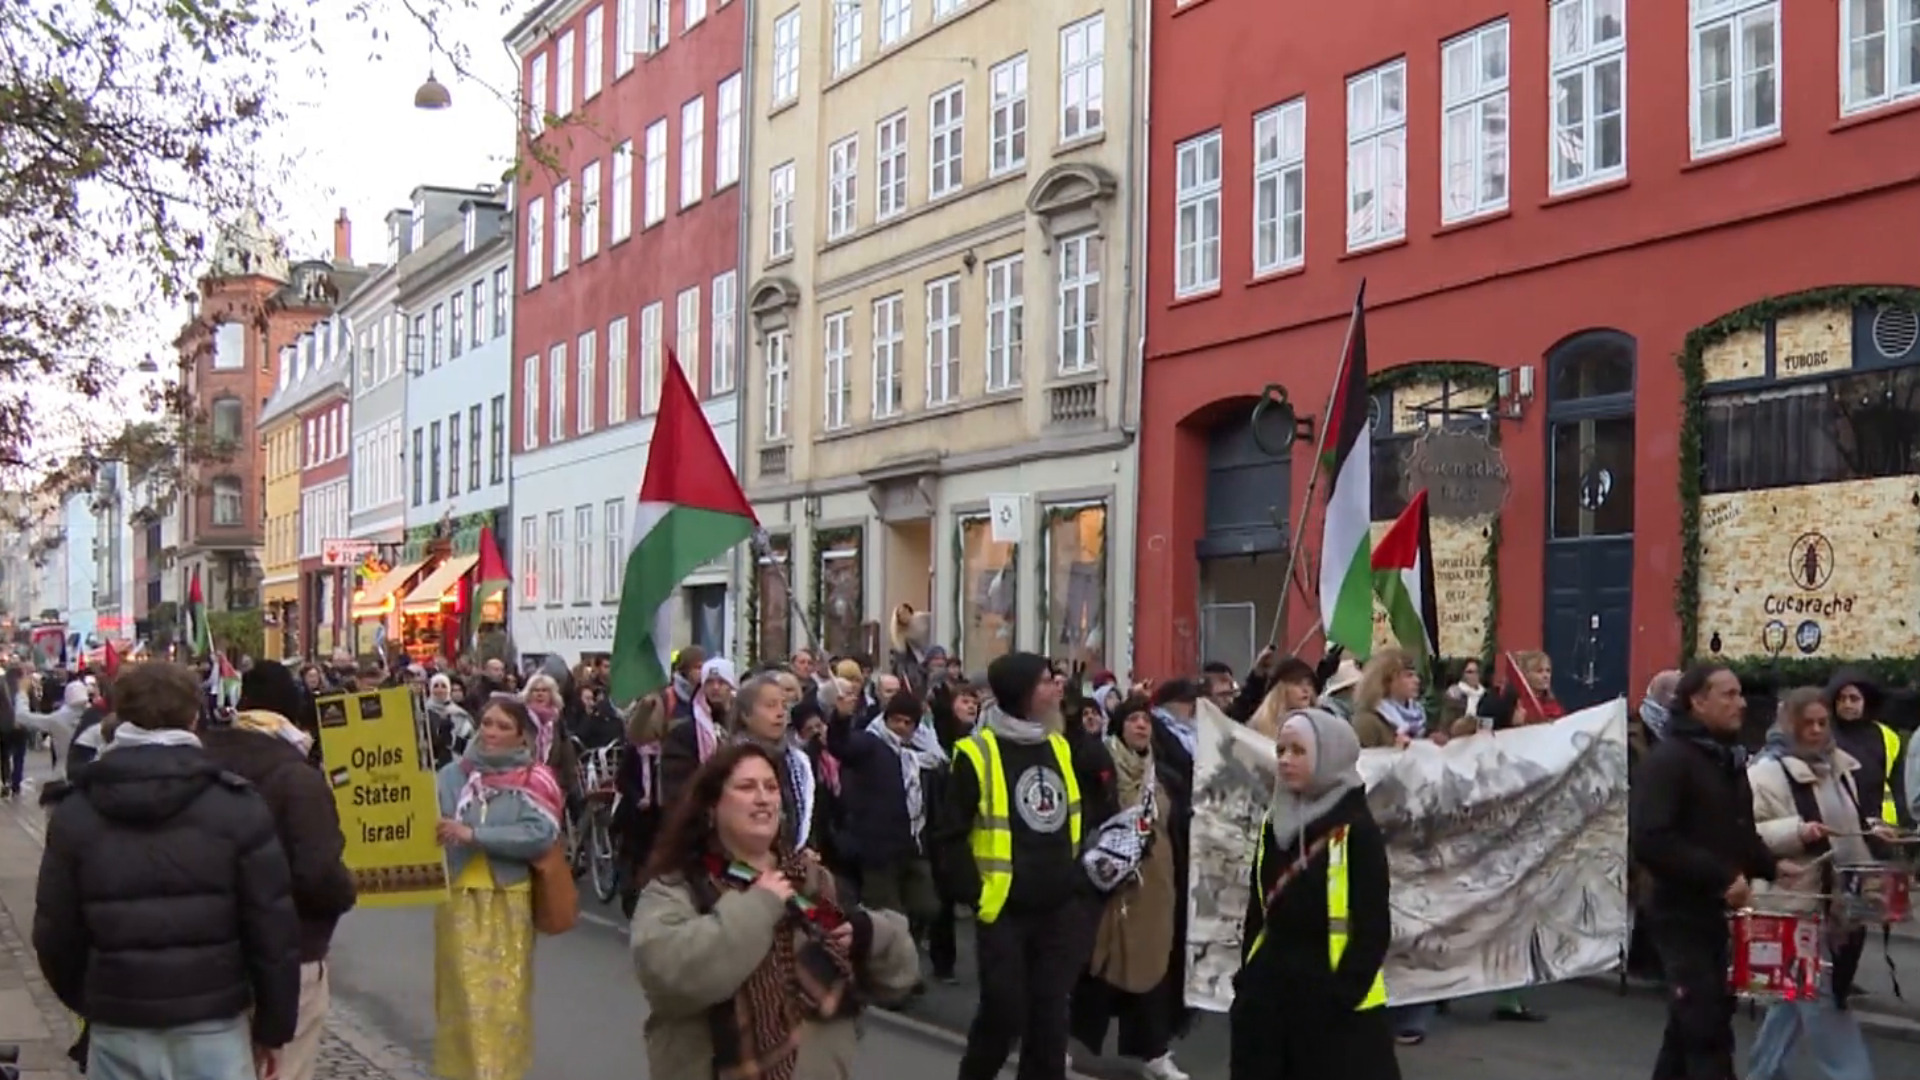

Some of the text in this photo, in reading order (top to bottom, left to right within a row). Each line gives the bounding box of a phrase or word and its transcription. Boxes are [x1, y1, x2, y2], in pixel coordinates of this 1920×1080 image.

[1784, 350, 1828, 370] TUBORG
[1764, 593, 1853, 617] Cucaracha
[351, 744, 403, 772] Opløs
[353, 783, 411, 806] Staten
